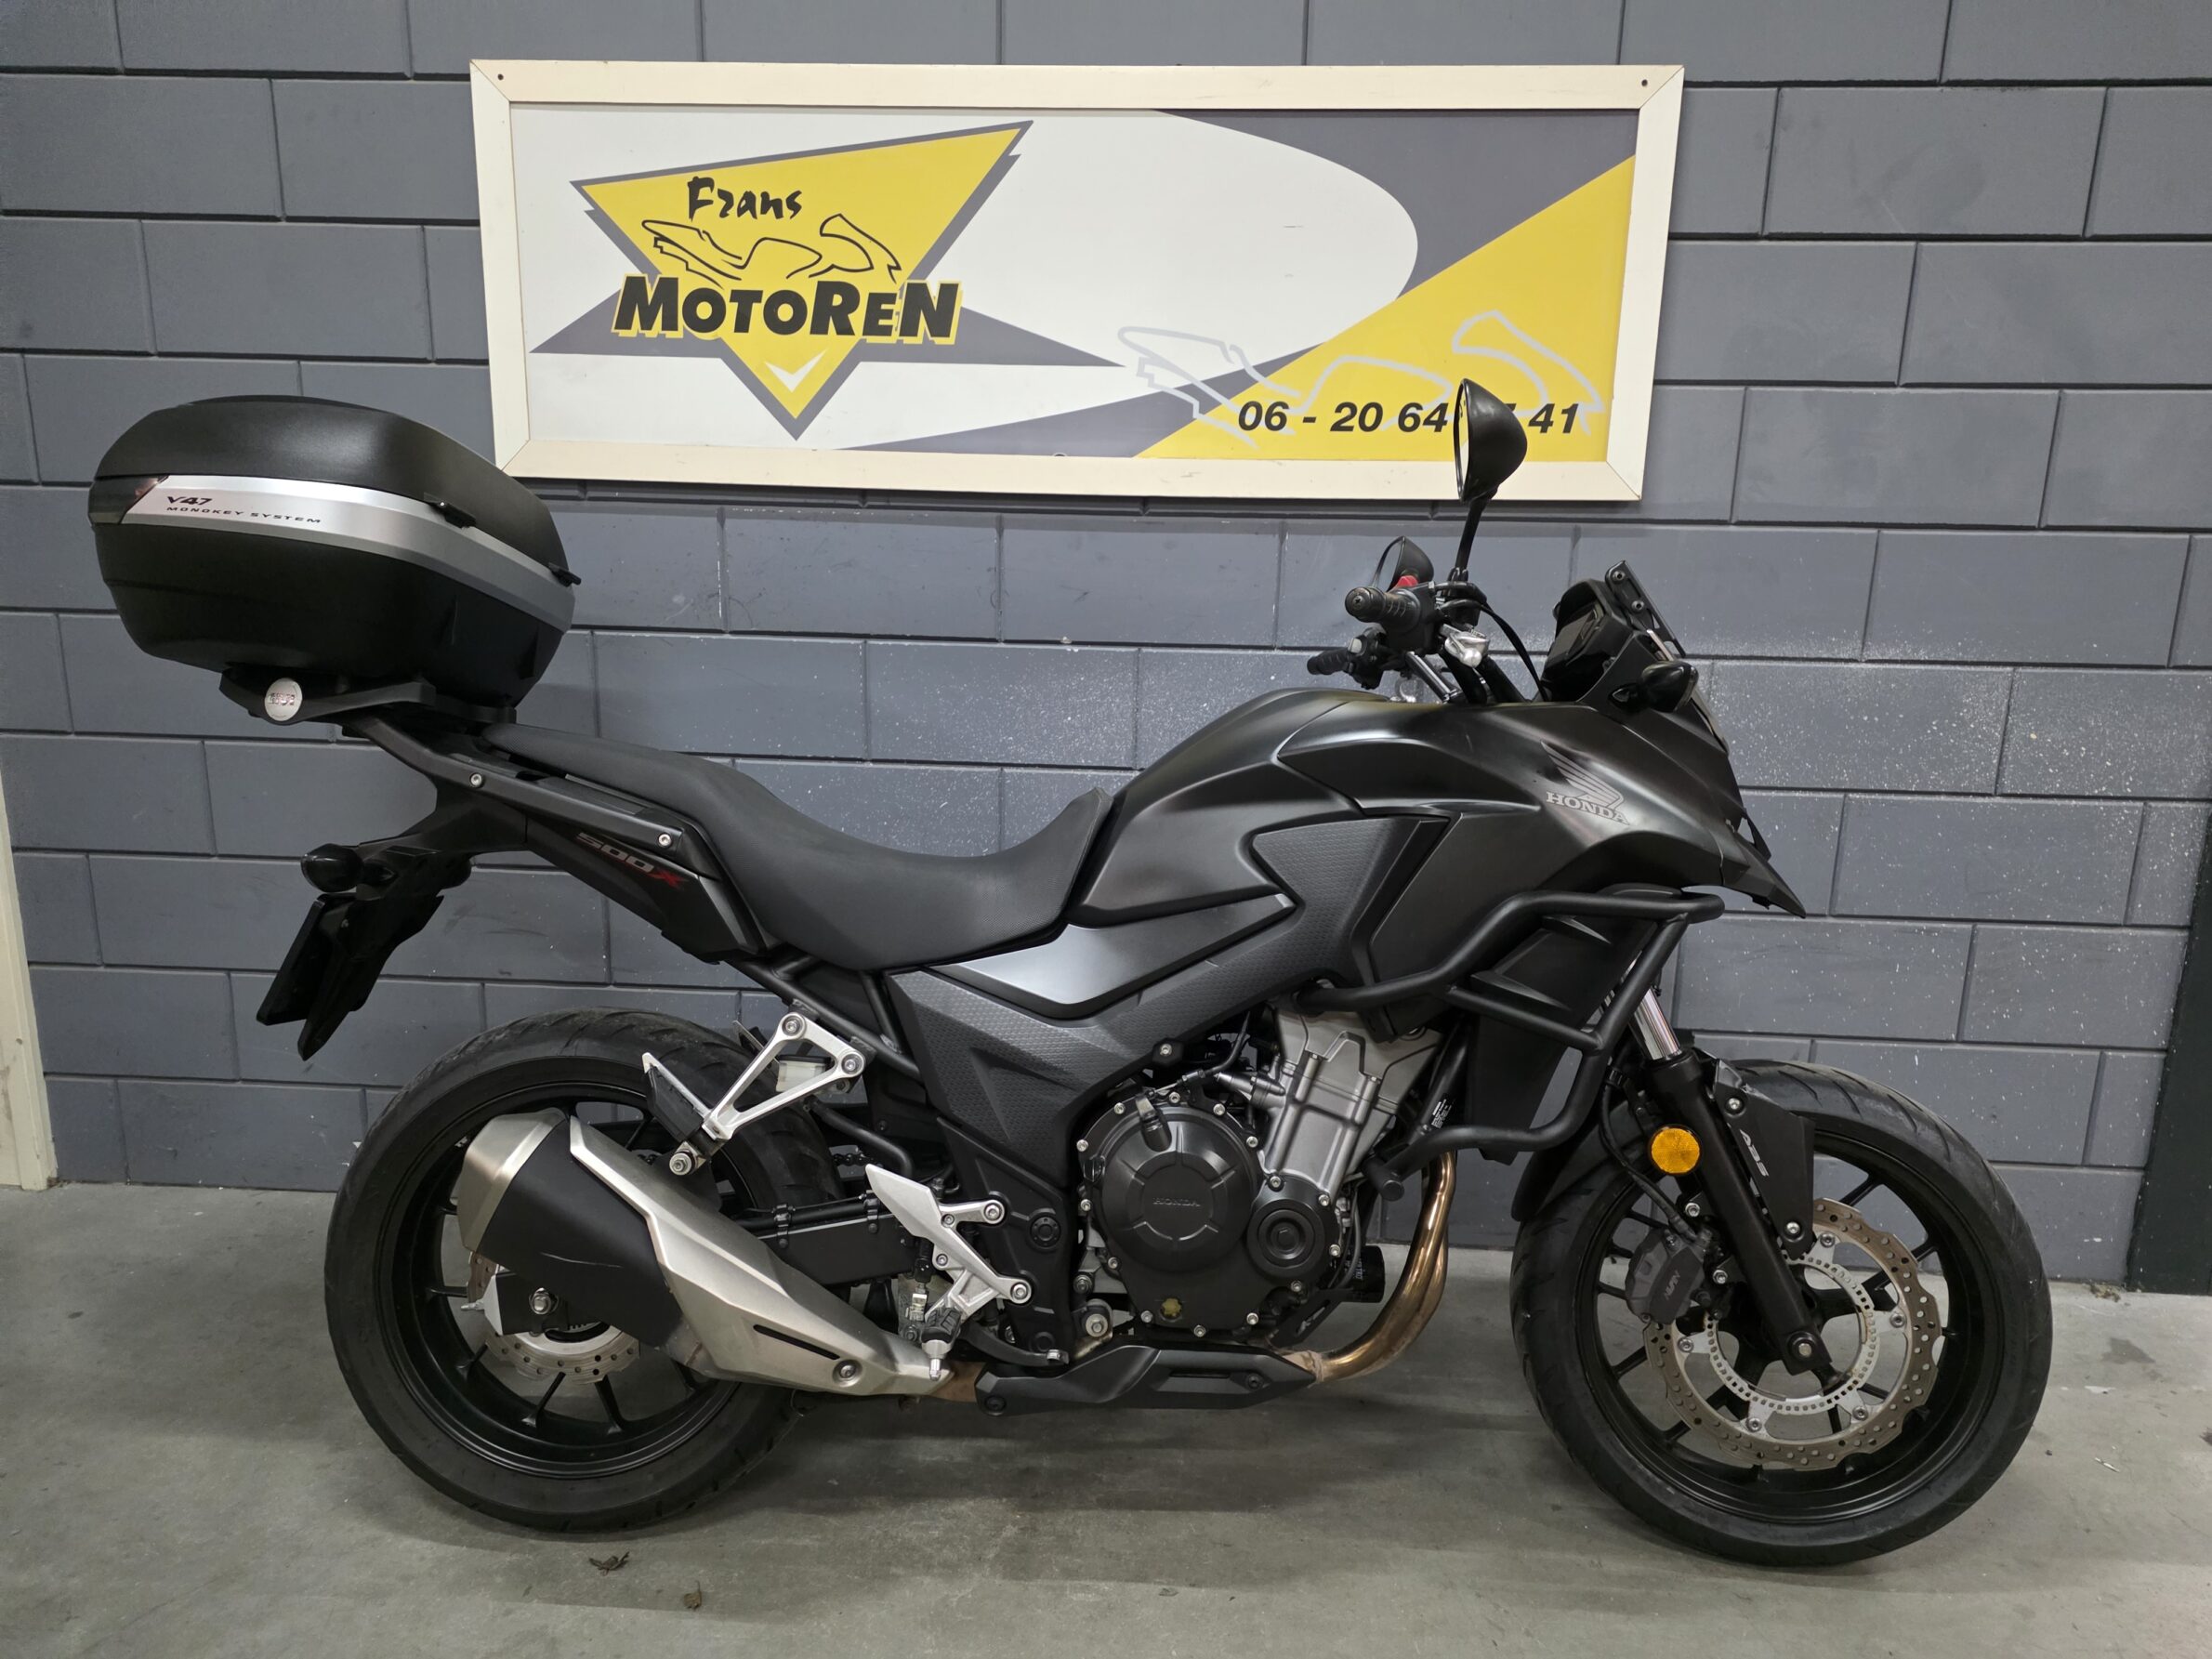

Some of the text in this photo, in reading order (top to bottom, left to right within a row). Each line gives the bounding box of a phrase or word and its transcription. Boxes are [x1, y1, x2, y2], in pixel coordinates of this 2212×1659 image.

[687, 176, 803, 222] Frans
[1238, 401, 1289, 431] 06
[1330, 402, 1383, 432] 20
[1397, 402, 1449, 433] 64
[1528, 402, 1579, 434] 41
[166, 495, 213, 507] V47
[166, 507, 322, 523] MONOKEY SYSTEM
[1546, 791, 1631, 825] HONDA
[1739, 1128, 1770, 1177] ABS
[1152, 1197, 1201, 1207] HONDA
